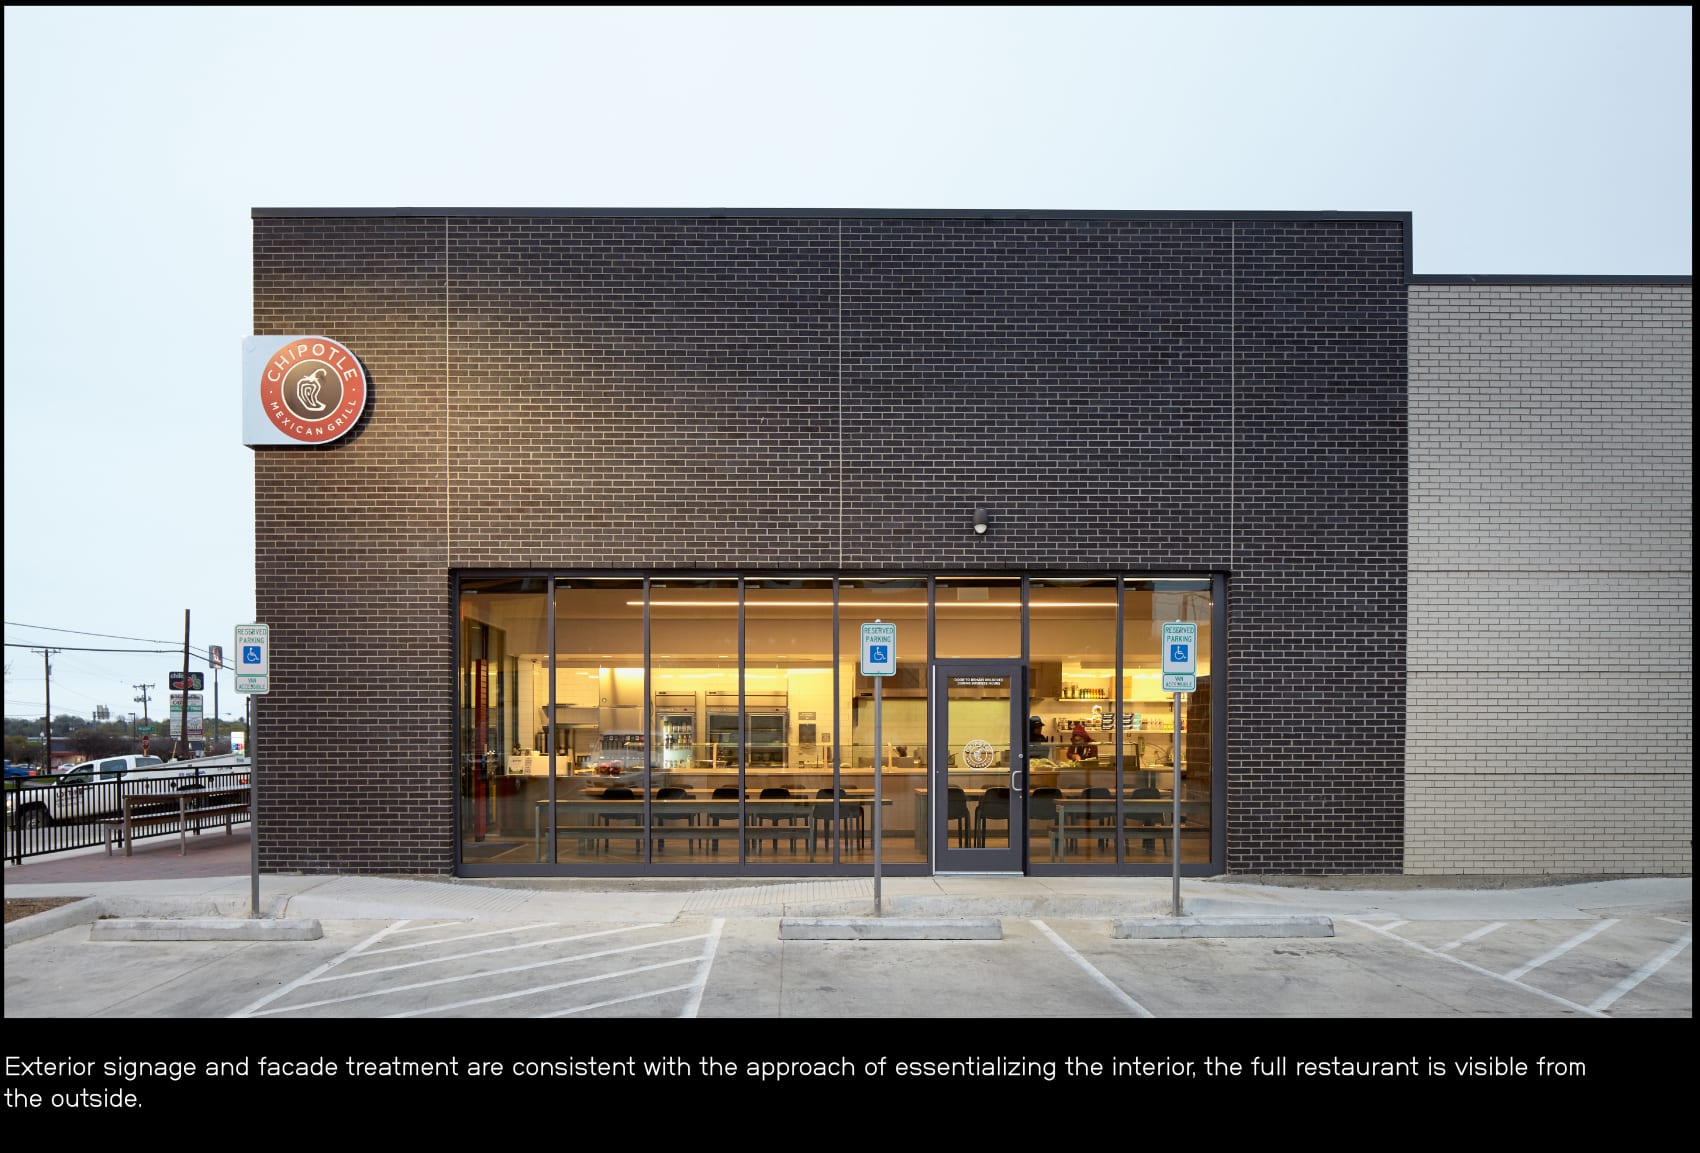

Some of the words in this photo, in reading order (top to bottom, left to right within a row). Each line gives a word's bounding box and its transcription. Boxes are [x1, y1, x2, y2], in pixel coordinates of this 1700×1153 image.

[267, 343, 358, 382] CHIPOTLE
[270, 401, 324, 435] MEXICAN
[327, 400, 357, 431] GRILL
[1165, 626, 1194, 634] RESERVED
[865, 635, 892, 643] PARKING
[1166, 635, 1193, 643] PARKING
